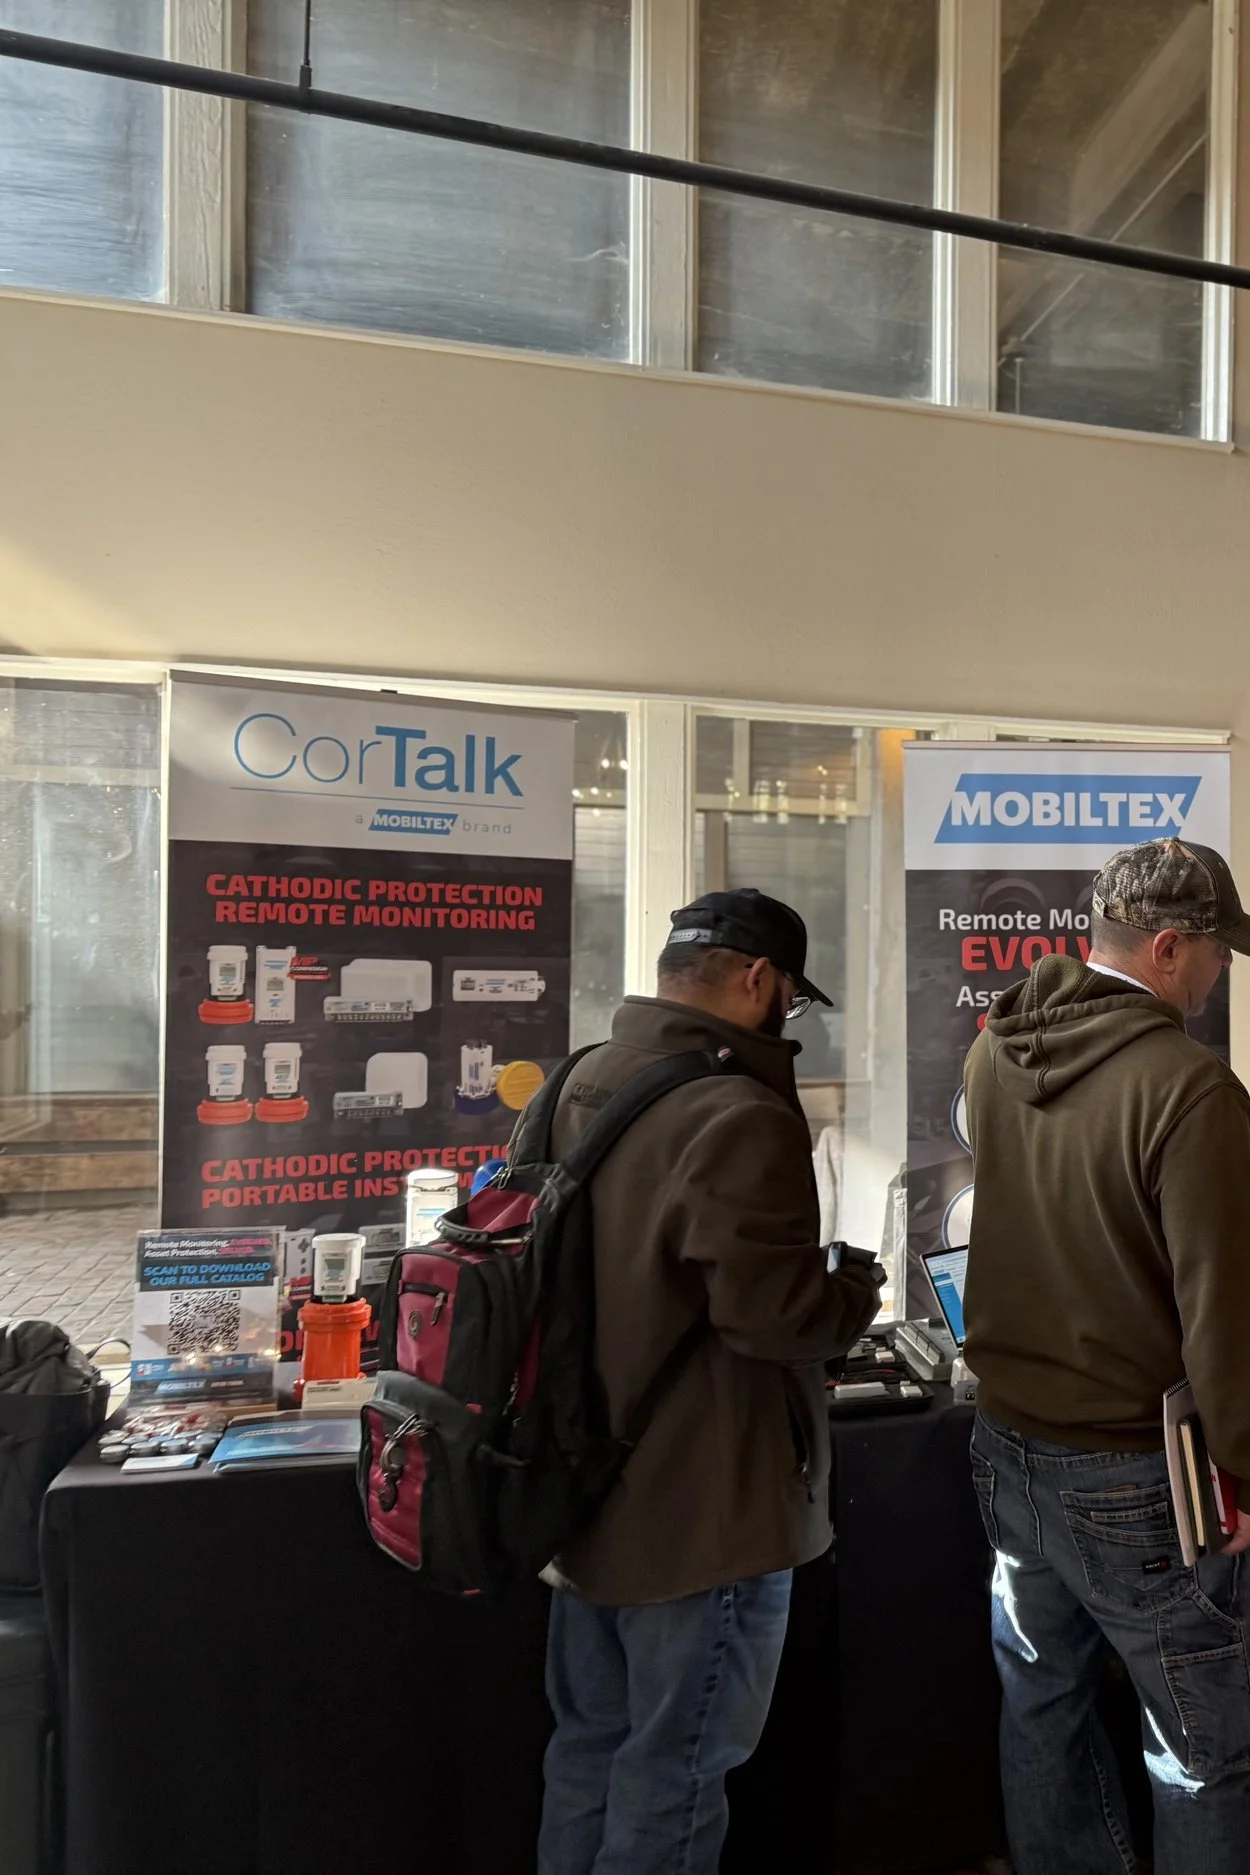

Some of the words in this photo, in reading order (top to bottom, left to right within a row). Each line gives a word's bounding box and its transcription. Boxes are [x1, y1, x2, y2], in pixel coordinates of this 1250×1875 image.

[234, 713, 524, 797] CorTalk
[952, 790, 1186, 827] MOBILTEX
[355, 813, 363, 825] a
[372, 813, 454, 832] MOBILTEX
[462, 819, 512, 835] brand
[206, 874, 362, 900] CATHODIC
[368, 880, 542, 907] PROTECTION
[215, 900, 346, 925] REMOTE
[353, 906, 536, 930] MONITORING
[939, 908, 1041, 930] Remote
[1049, 909, 1090, 930] Mo
[202, 1152, 358, 1183] CATHODIC
[202, 1180, 348, 1209] PORTABLE
[144, 1266, 179, 1276] SCAN
[180, 1264, 198, 1274] TO
[199, 1262, 271, 1274] DOWNLOAD
[149, 1277, 177, 1286] OUR
[180, 1275, 208, 1284] FULL
[210, 1272, 265, 1283] CATALOG
